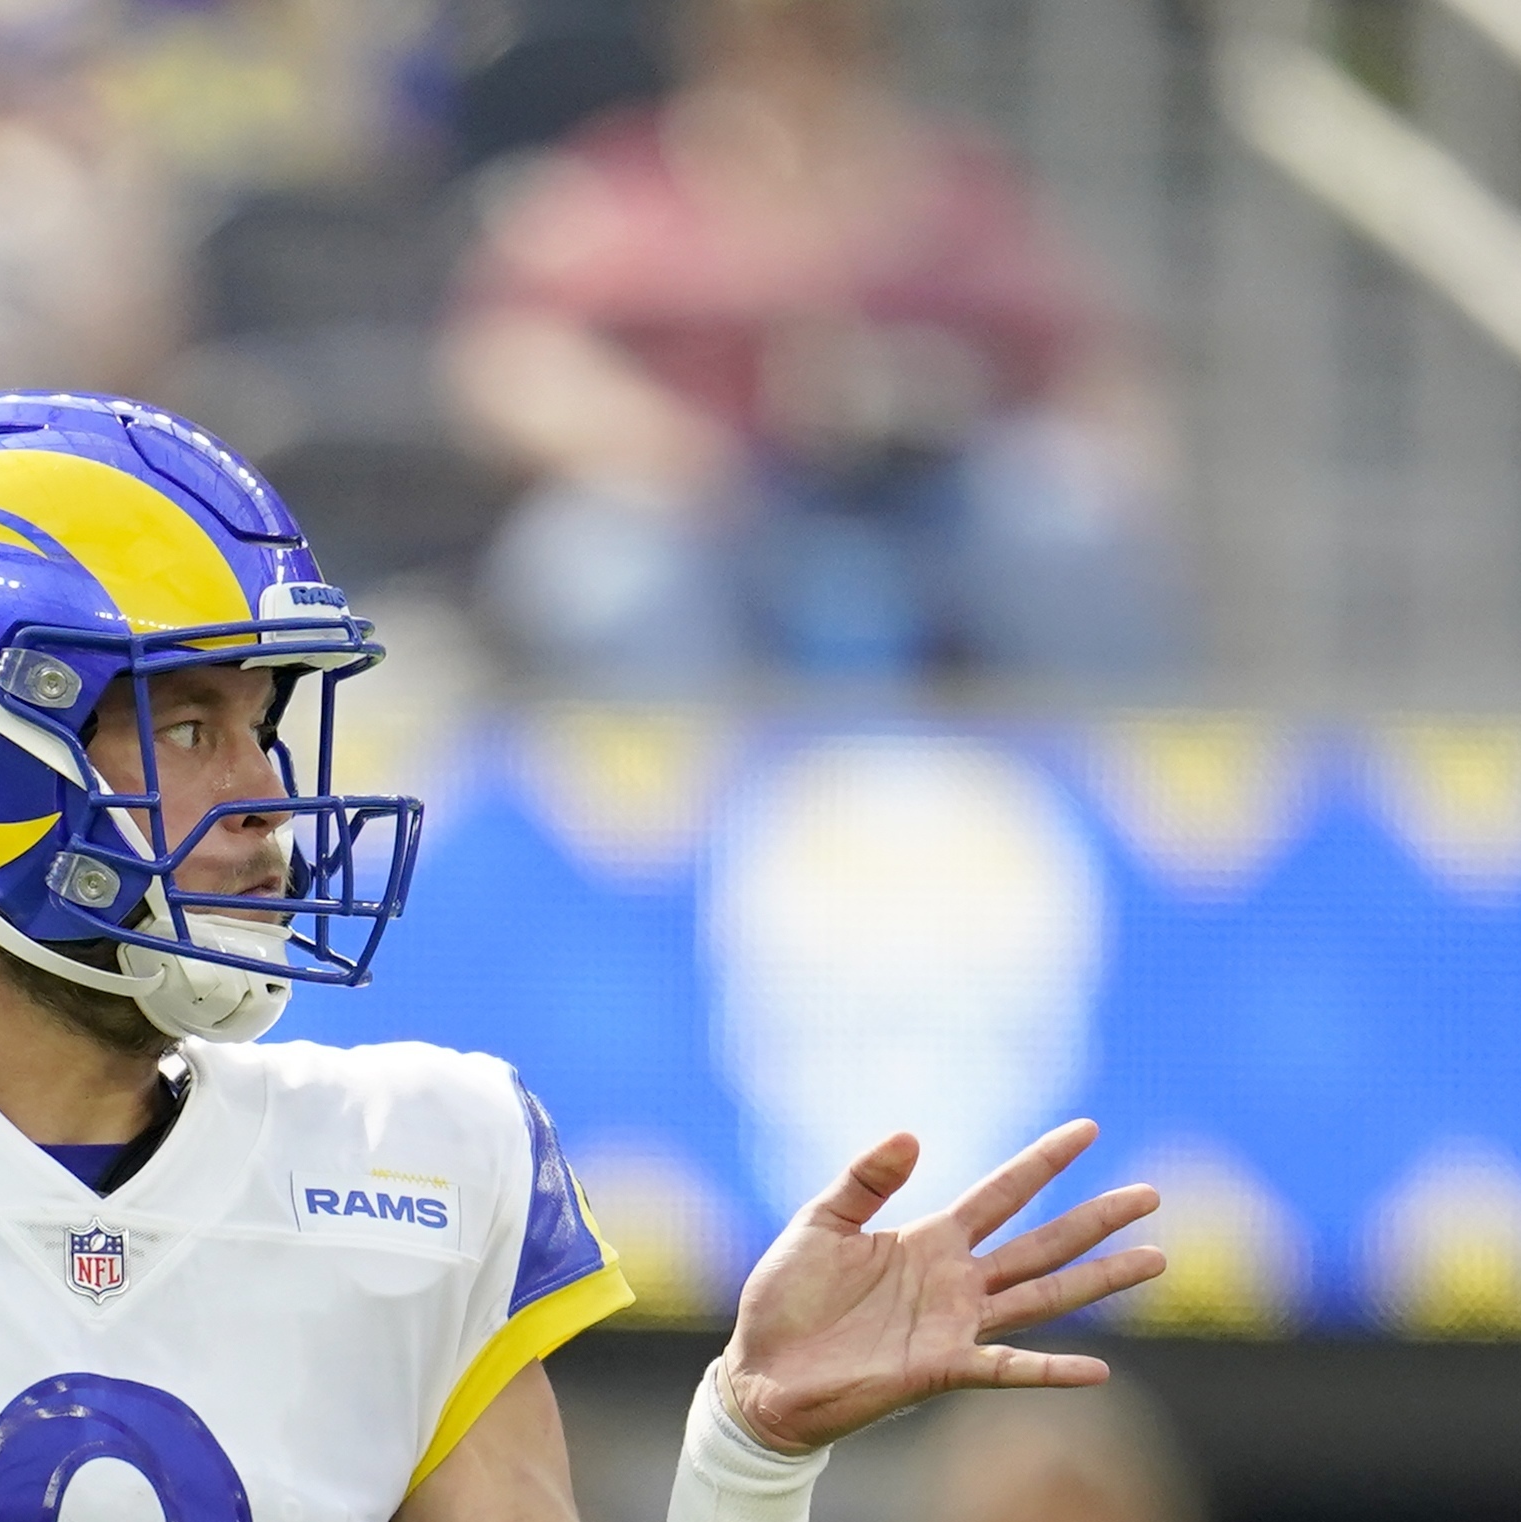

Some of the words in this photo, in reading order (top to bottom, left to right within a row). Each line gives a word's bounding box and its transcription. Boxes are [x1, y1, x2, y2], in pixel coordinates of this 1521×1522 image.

[289, 586, 347, 610] RAMS
[305, 1188, 448, 1229] RAMS
[77, 1256, 120, 1288] NFL
